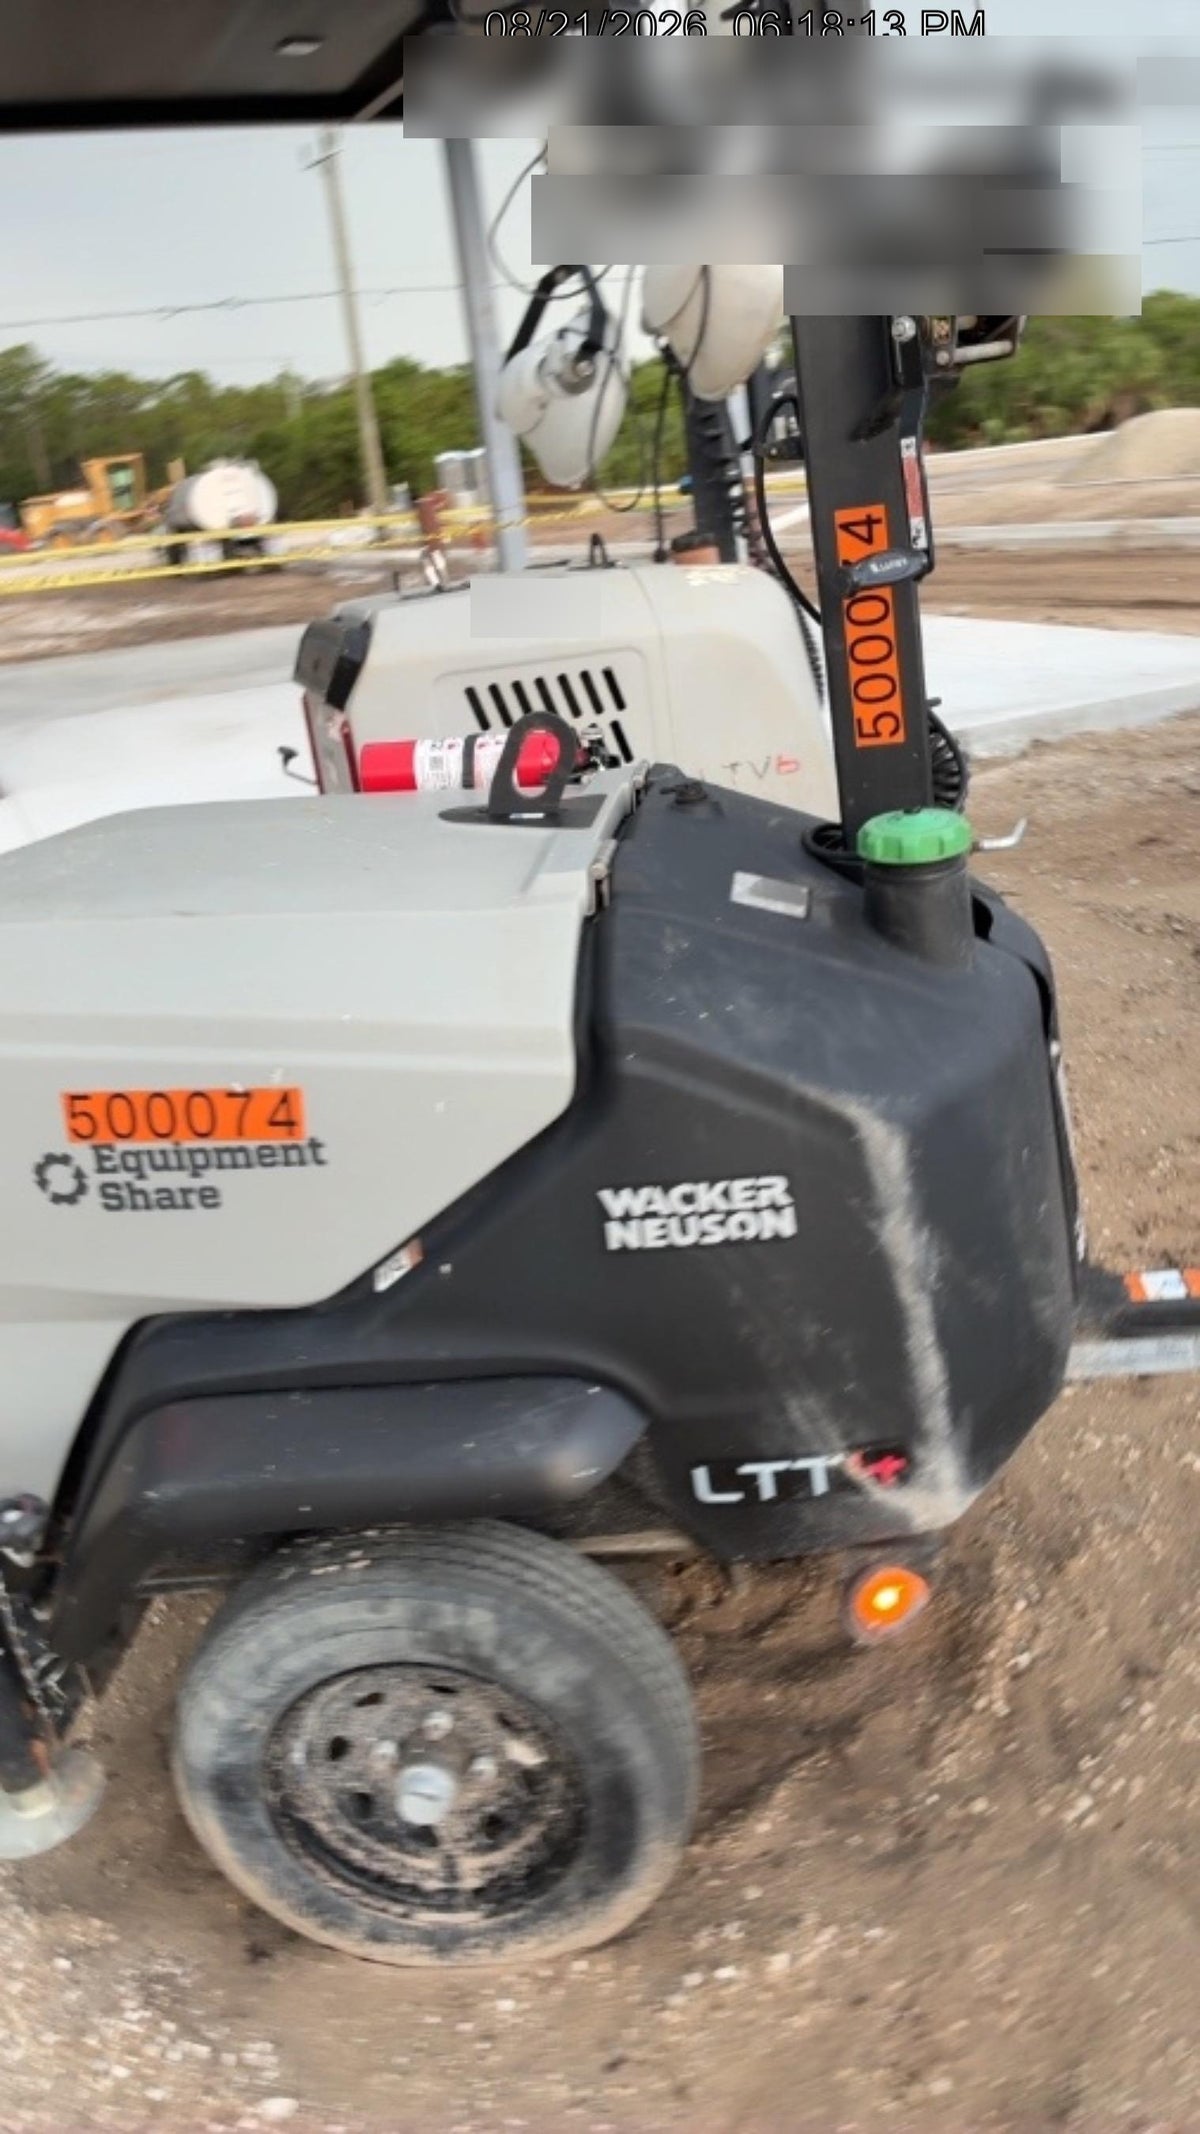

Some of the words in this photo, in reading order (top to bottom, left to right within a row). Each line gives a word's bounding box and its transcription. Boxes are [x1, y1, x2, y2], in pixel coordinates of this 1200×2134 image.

[838, 514, 901, 739] 50004
[67, 1091, 299, 1139] 500074
[91, 1138, 327, 1179] Equipment
[99, 1180, 222, 1212] Share
[597, 1175, 795, 1219] WACKER
[604, 1205, 798, 1251] NEUSON
